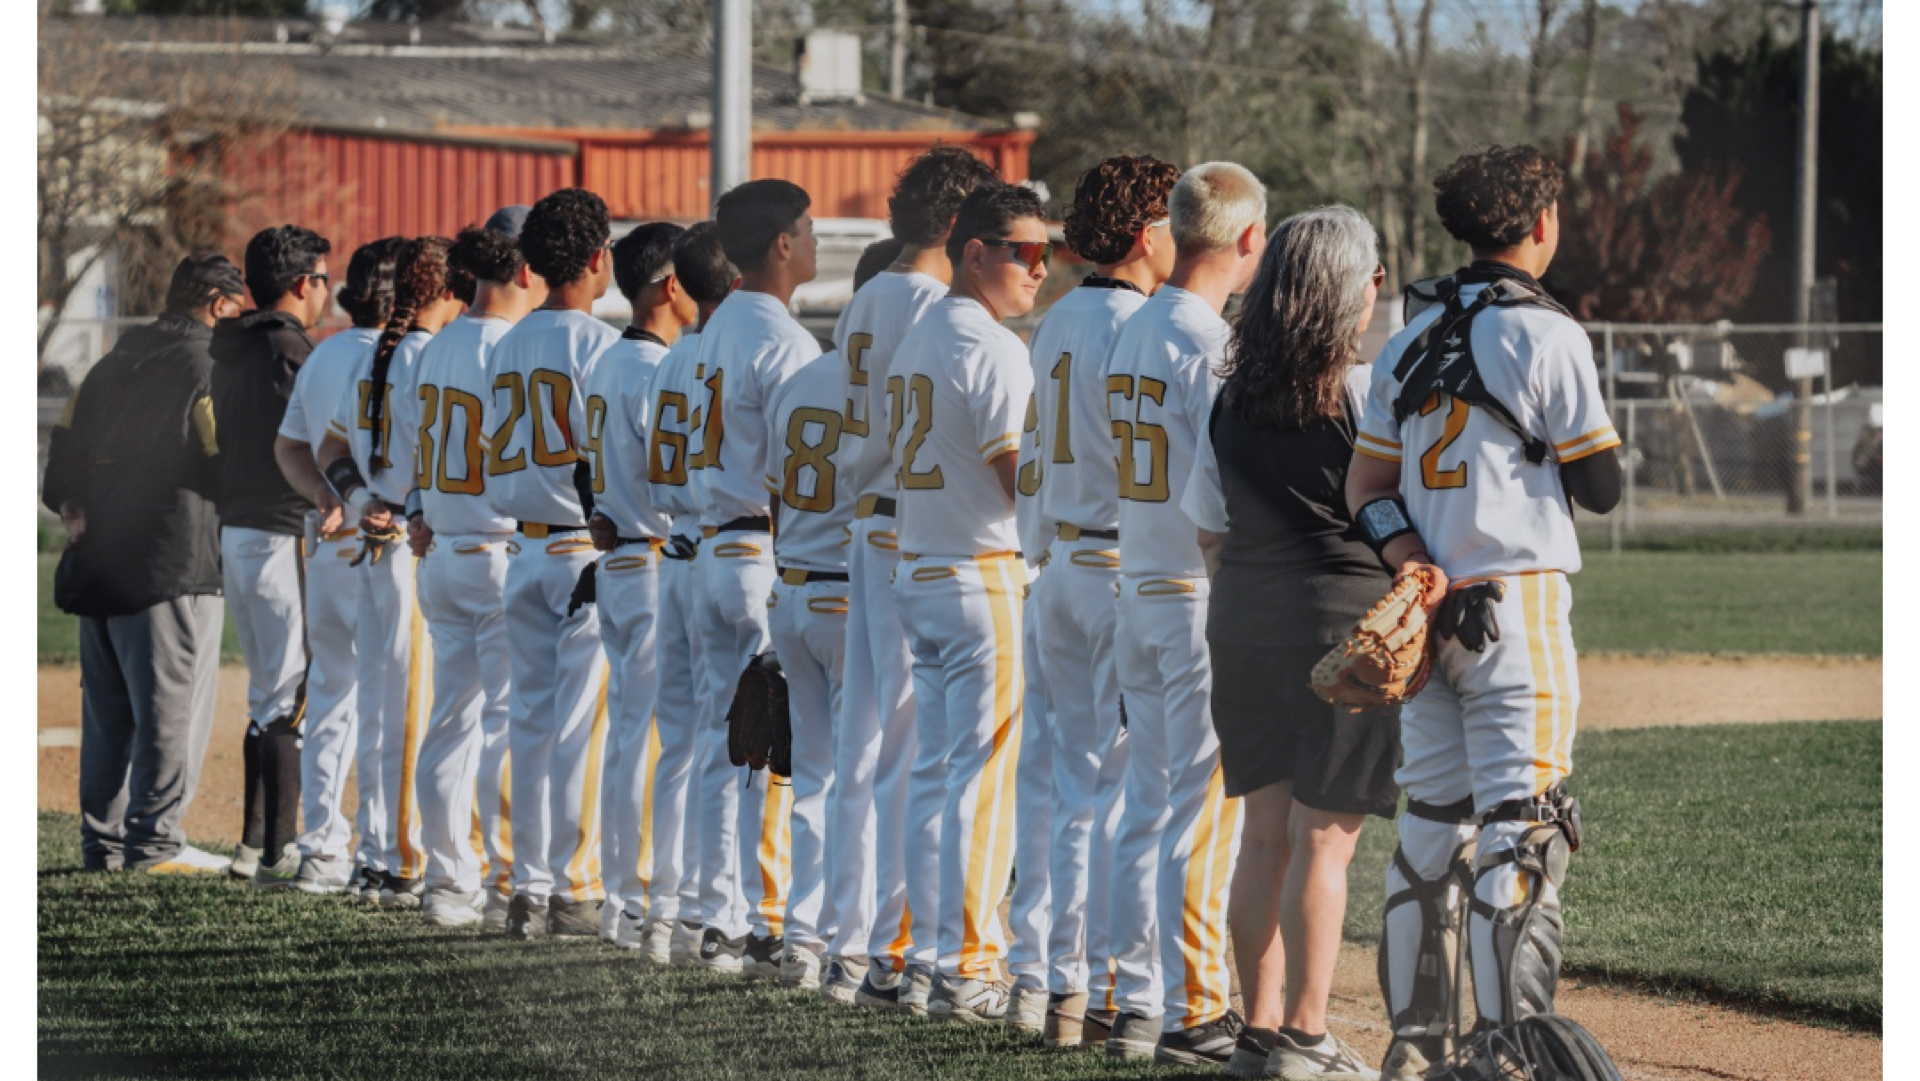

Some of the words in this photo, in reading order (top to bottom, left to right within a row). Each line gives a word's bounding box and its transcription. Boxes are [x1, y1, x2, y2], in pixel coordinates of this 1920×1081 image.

[418, 384, 485, 496] 30
[489, 368, 578, 477] 20
[782, 406, 843, 513] 8
[1419, 388, 1469, 489] 2
